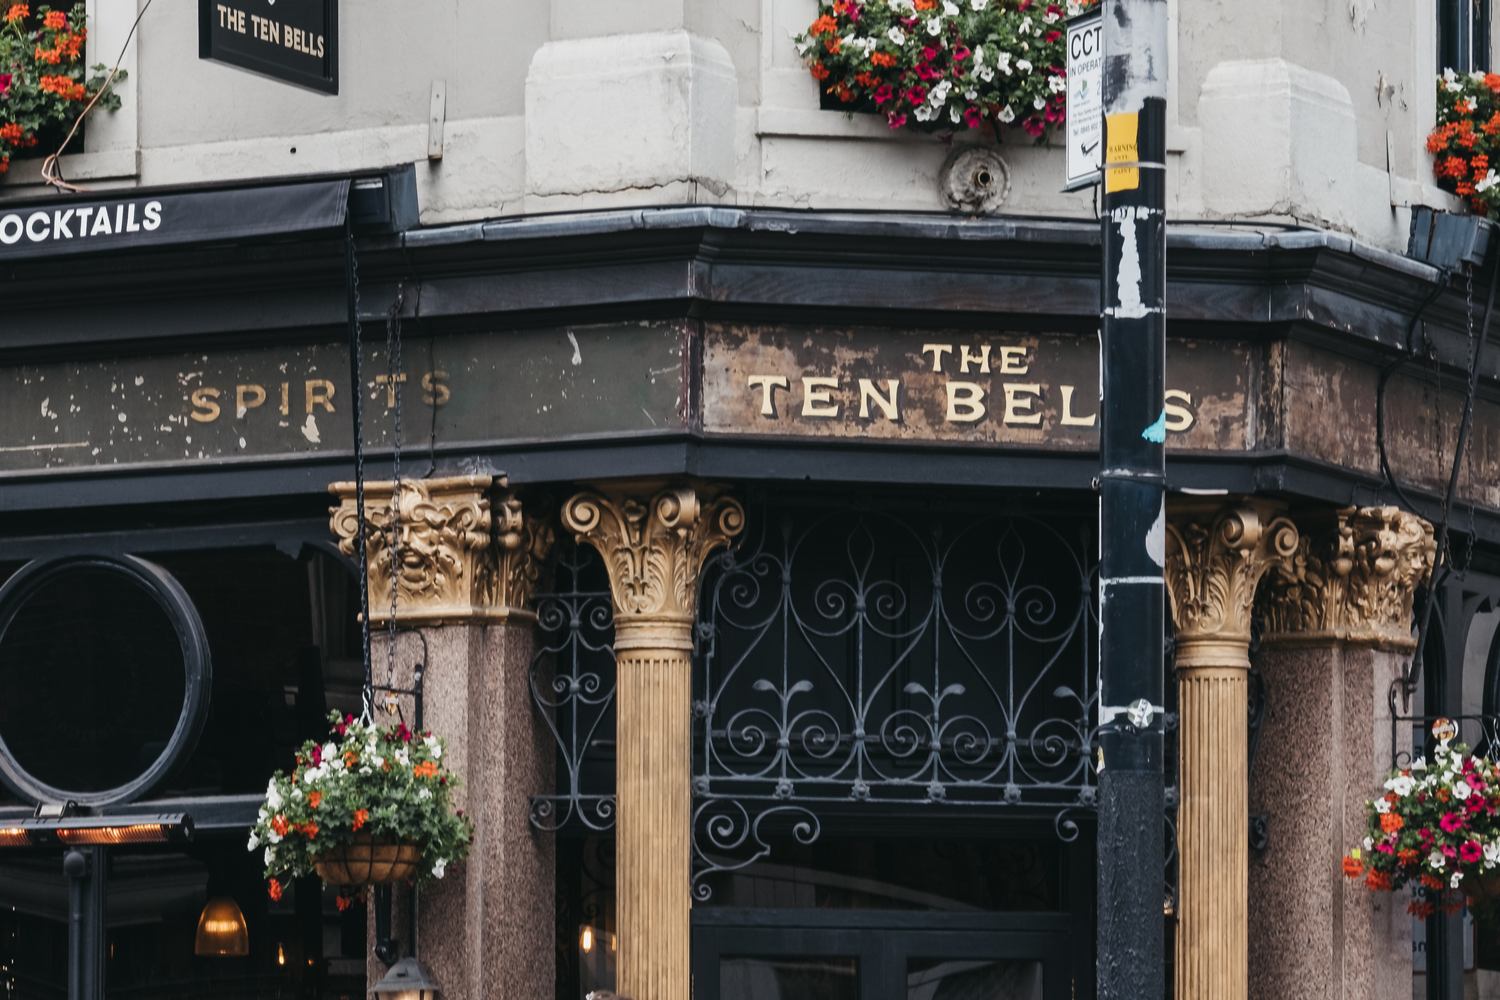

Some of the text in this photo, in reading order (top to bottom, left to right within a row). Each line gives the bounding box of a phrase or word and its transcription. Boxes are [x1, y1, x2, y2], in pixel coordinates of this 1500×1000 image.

[217, 4, 324, 58] THE TEN BELLS
[1071, 26, 1102, 60] CCT
[1070, 57, 1102, 77] IN OPERAT
[922, 344, 1029, 375] THE
[190, 370, 450, 423] SPIRTS
[748, 375, 1193, 433] TEN BELS
